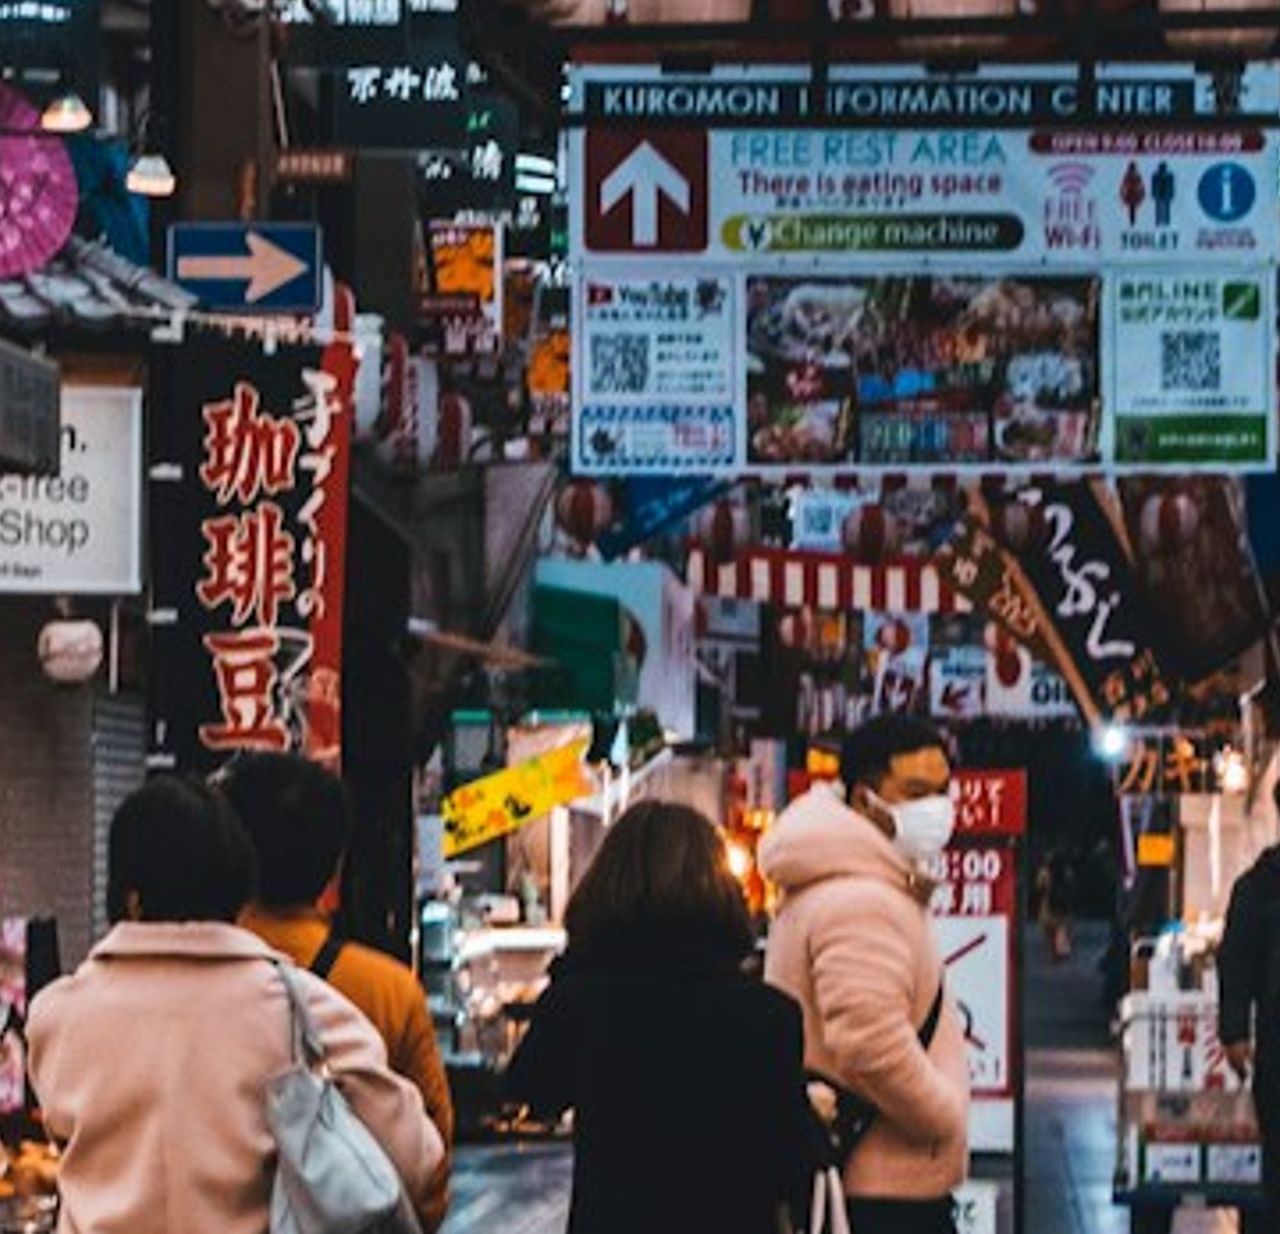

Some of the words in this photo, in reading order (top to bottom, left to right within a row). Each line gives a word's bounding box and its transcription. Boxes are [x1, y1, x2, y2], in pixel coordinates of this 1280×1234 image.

[604, 87, 779, 115] KUROMON
[798, 87, 1032, 115] IFORMATION
[1050, 87, 1174, 114] CNTER
[730, 131, 811, 165] FREE
[822, 131, 899, 166] REST
[909, 131, 1008, 165] AREA
[739, 170, 809, 196] There
[816, 170, 834, 196] is
[841, 170, 922, 197] eating
[930, 171, 1002, 196] space
[779, 222, 870, 250] Change
[882, 222, 1000, 244] machine
[1121, 232, 1180, 251] TOILET
[198, 384, 300, 753] 珈琲豆
